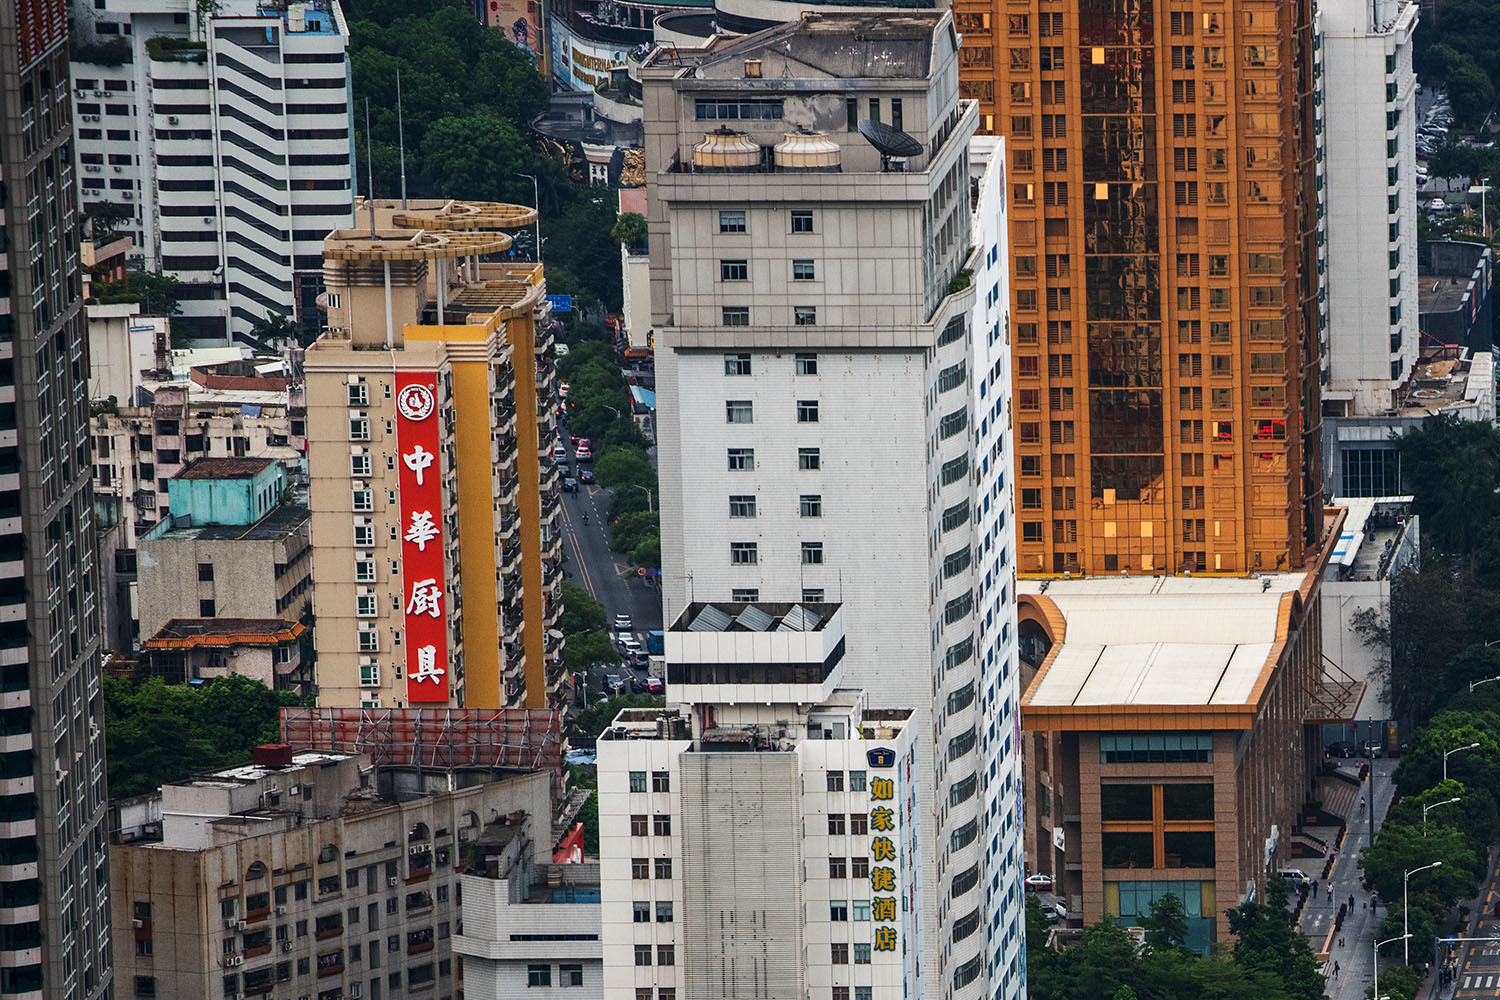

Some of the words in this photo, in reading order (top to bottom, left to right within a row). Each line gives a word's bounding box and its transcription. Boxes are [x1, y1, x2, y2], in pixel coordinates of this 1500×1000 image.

[403, 445, 445, 685] 中華厨具
[870, 776, 897, 952] 如家快捷酒店
